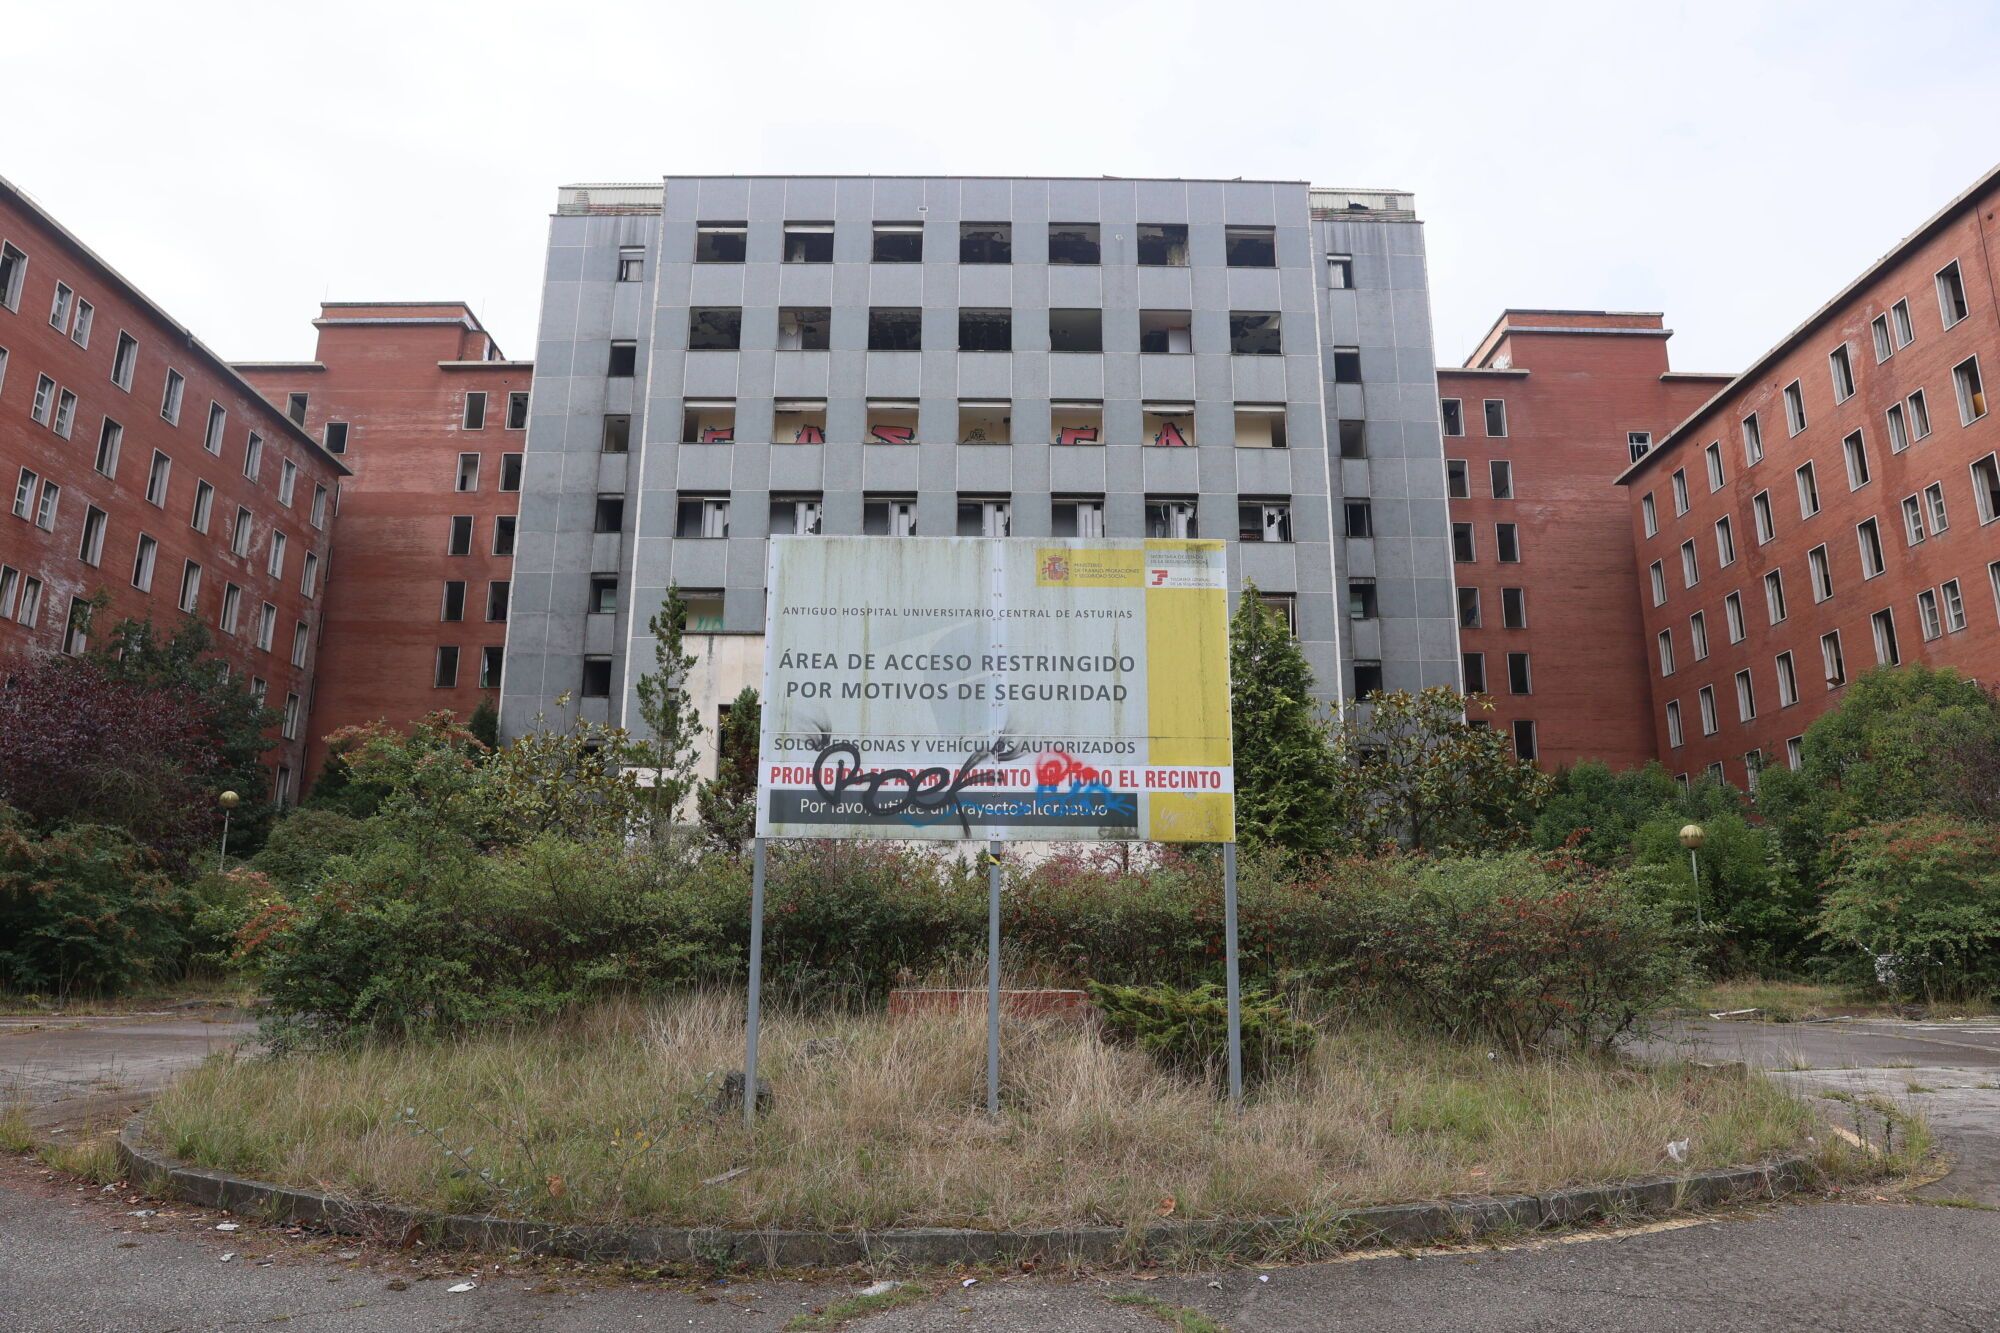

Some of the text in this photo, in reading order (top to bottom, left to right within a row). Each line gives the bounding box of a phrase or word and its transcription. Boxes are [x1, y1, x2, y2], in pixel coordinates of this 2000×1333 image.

[782, 606, 1133, 619] ANTIGUO HOSPITAL UNIVERSITARIO CENTRAL DE ASTURIAS
[778, 648, 1135, 673] ÁREA DE ACCESO RESTRINGIDO
[786, 681, 1128, 702] POR MOTIVOS DE SEGURIDAD
[774, 737, 815, 751] SOLO
[821, 738, 905, 752] SONAS
[911, 739, 920, 752] Y
[1020, 740, 1136, 754] AUTORIZADOS
[770, 766, 864, 785] PROHIBDO
[894, 767, 1031, 787] APRAMIENTO
[1119, 769, 1139, 788] EL
[1145, 770, 1221, 789] RECINTO
[800, 798, 826, 814] Por
[830, 798, 872, 817] avo,
